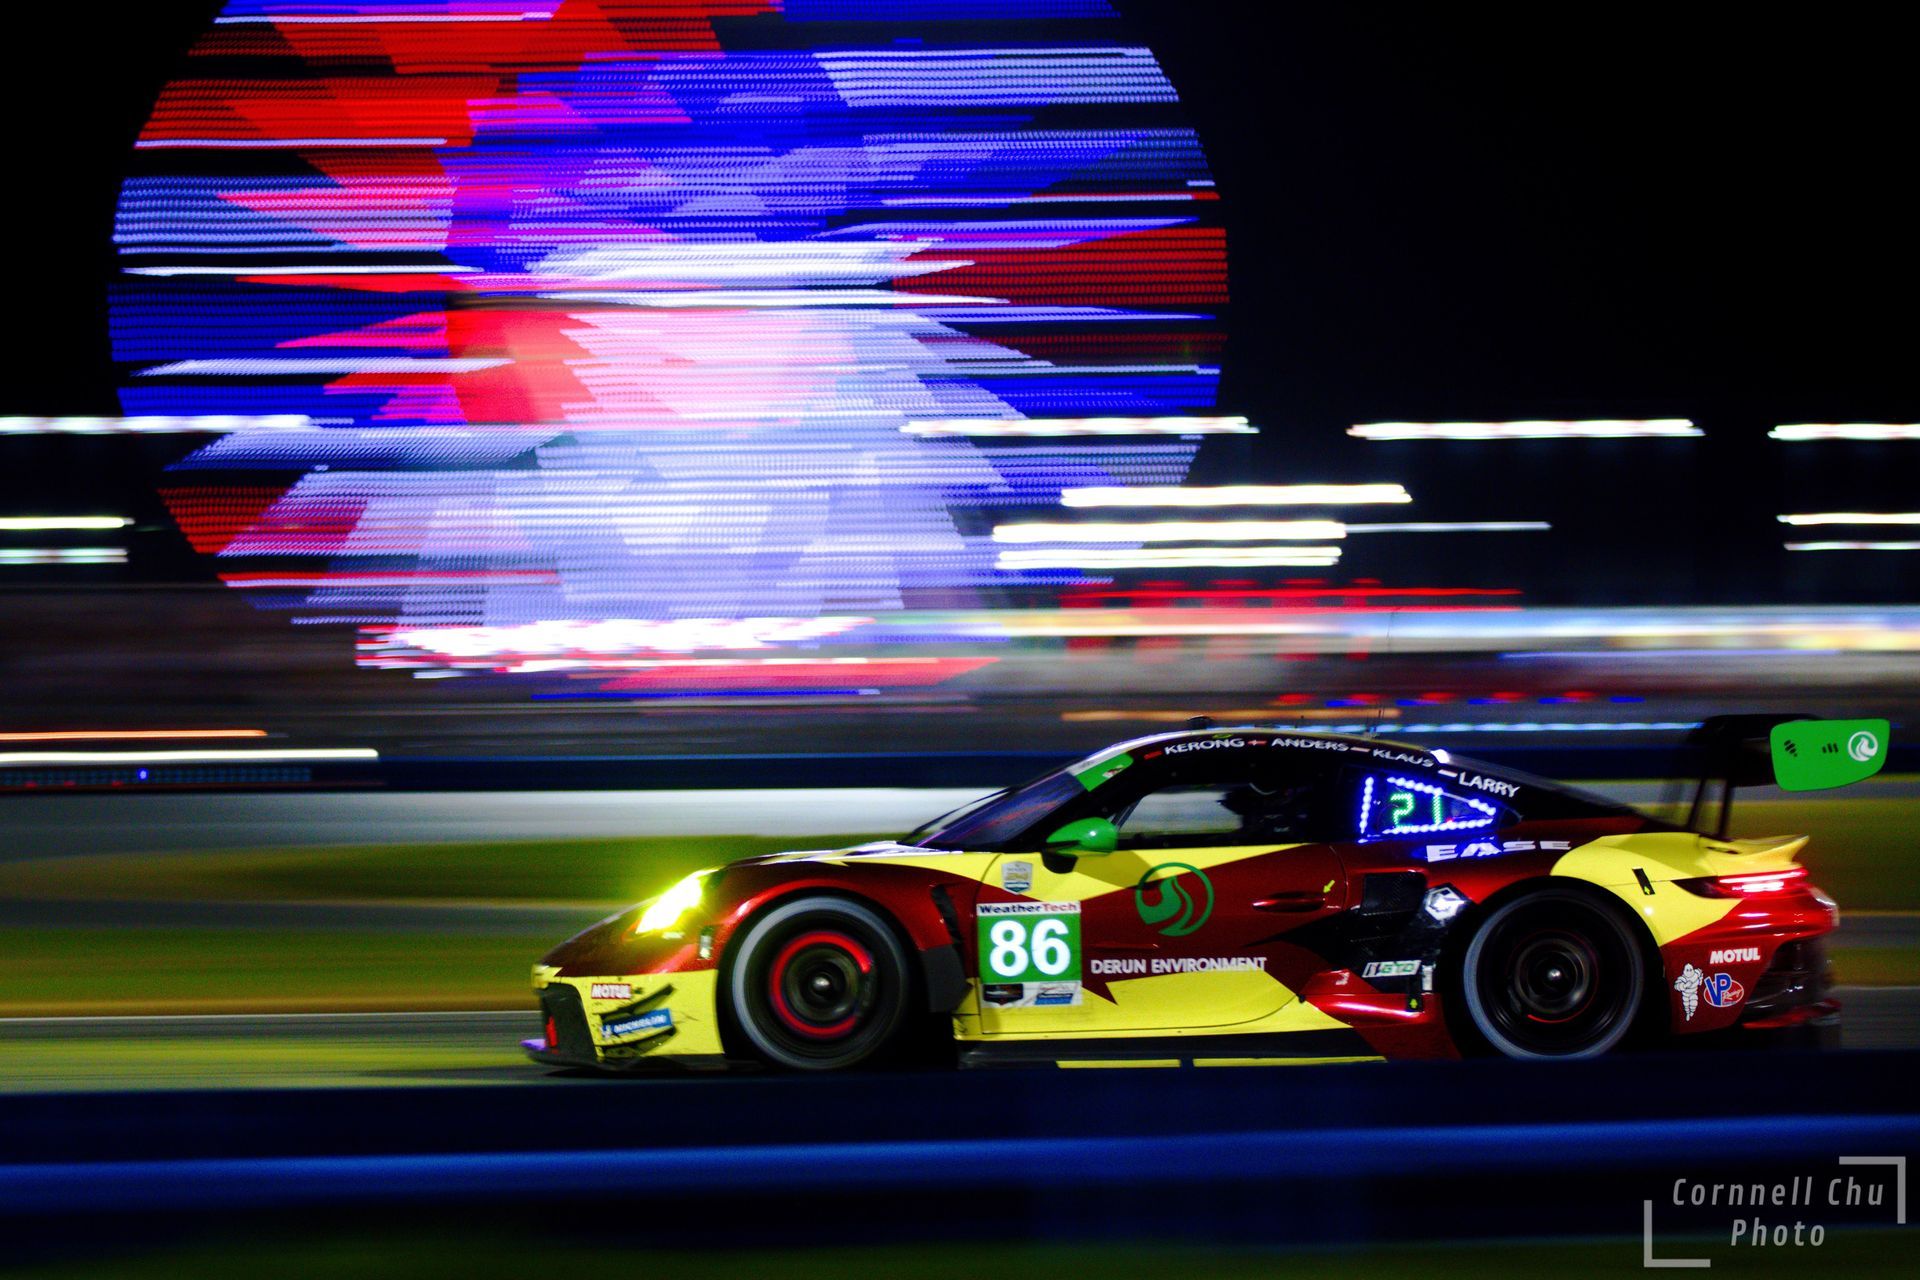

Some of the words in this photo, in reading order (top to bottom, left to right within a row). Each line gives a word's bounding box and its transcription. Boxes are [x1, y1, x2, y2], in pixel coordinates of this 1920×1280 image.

[1164, 738, 1246, 756] KERONG
[1271, 737, 1350, 753] ANDERS
[1372, 749, 1436, 769] KLAUS
[1459, 772, 1520, 798] LARRY
[979, 902, 1077, 914] WeatherTech
[989, 918, 1071, 977] 86
[1709, 947, 1761, 964] MOTUL
[1091, 959, 1146, 974] DERUN
[1151, 957, 1267, 973] ENVIRONMENT
[591, 984, 632, 999] MOTUL
[1704, 973, 1732, 1007] VP
